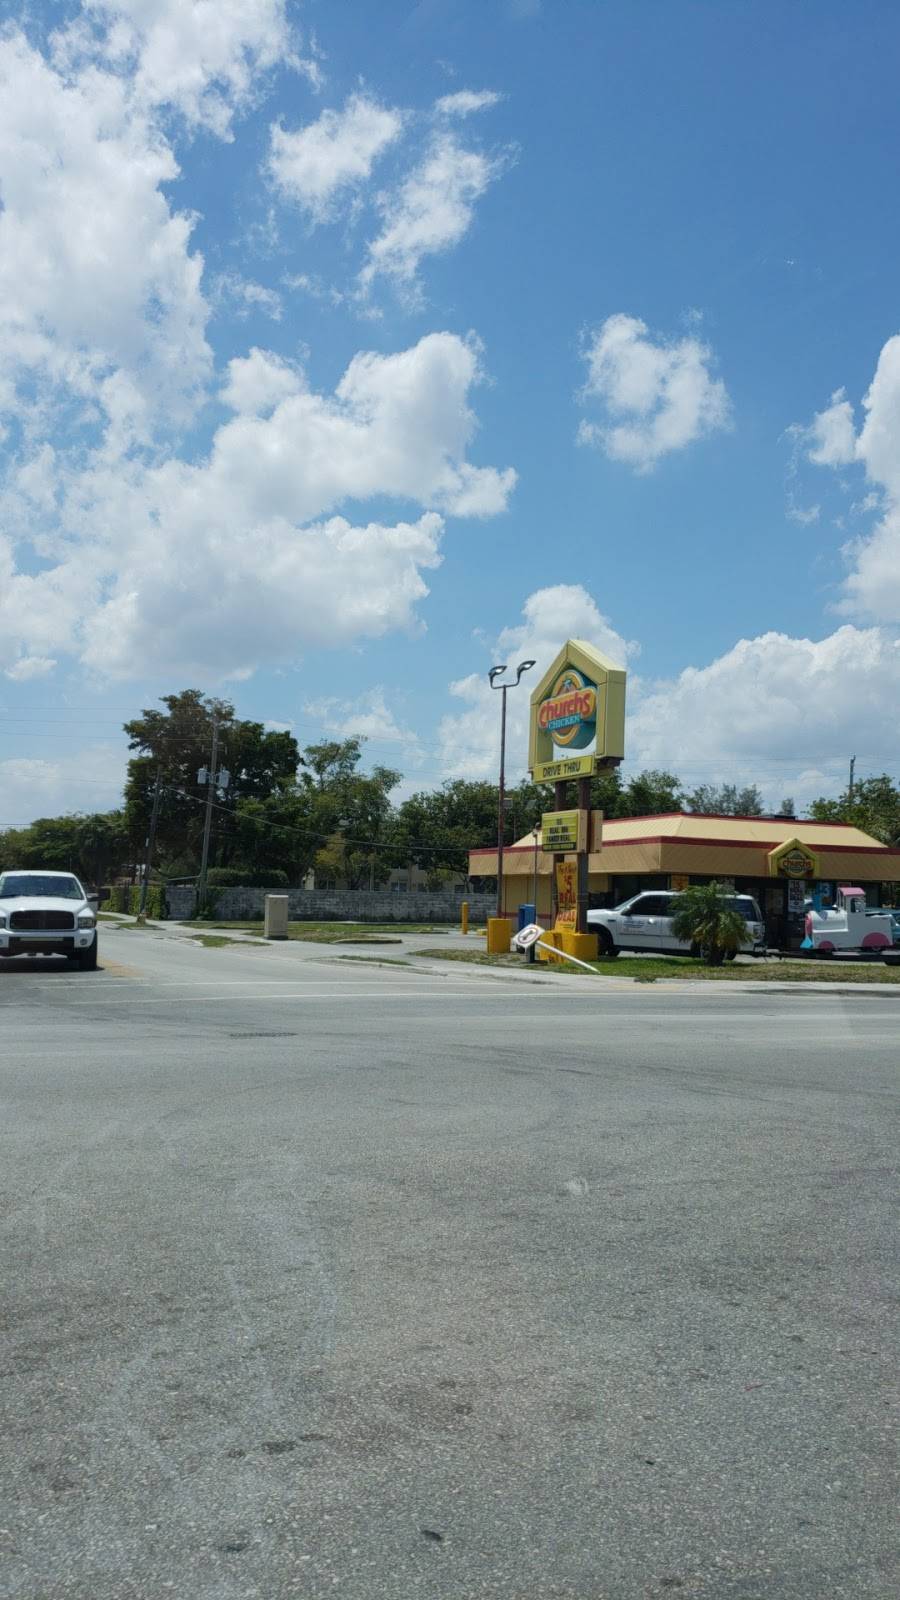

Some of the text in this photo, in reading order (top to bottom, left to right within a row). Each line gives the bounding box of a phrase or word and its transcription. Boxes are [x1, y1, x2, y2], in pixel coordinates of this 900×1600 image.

[548, 714, 580, 730] CHICKEN
[543, 760, 581, 778] DRIVE THRU
